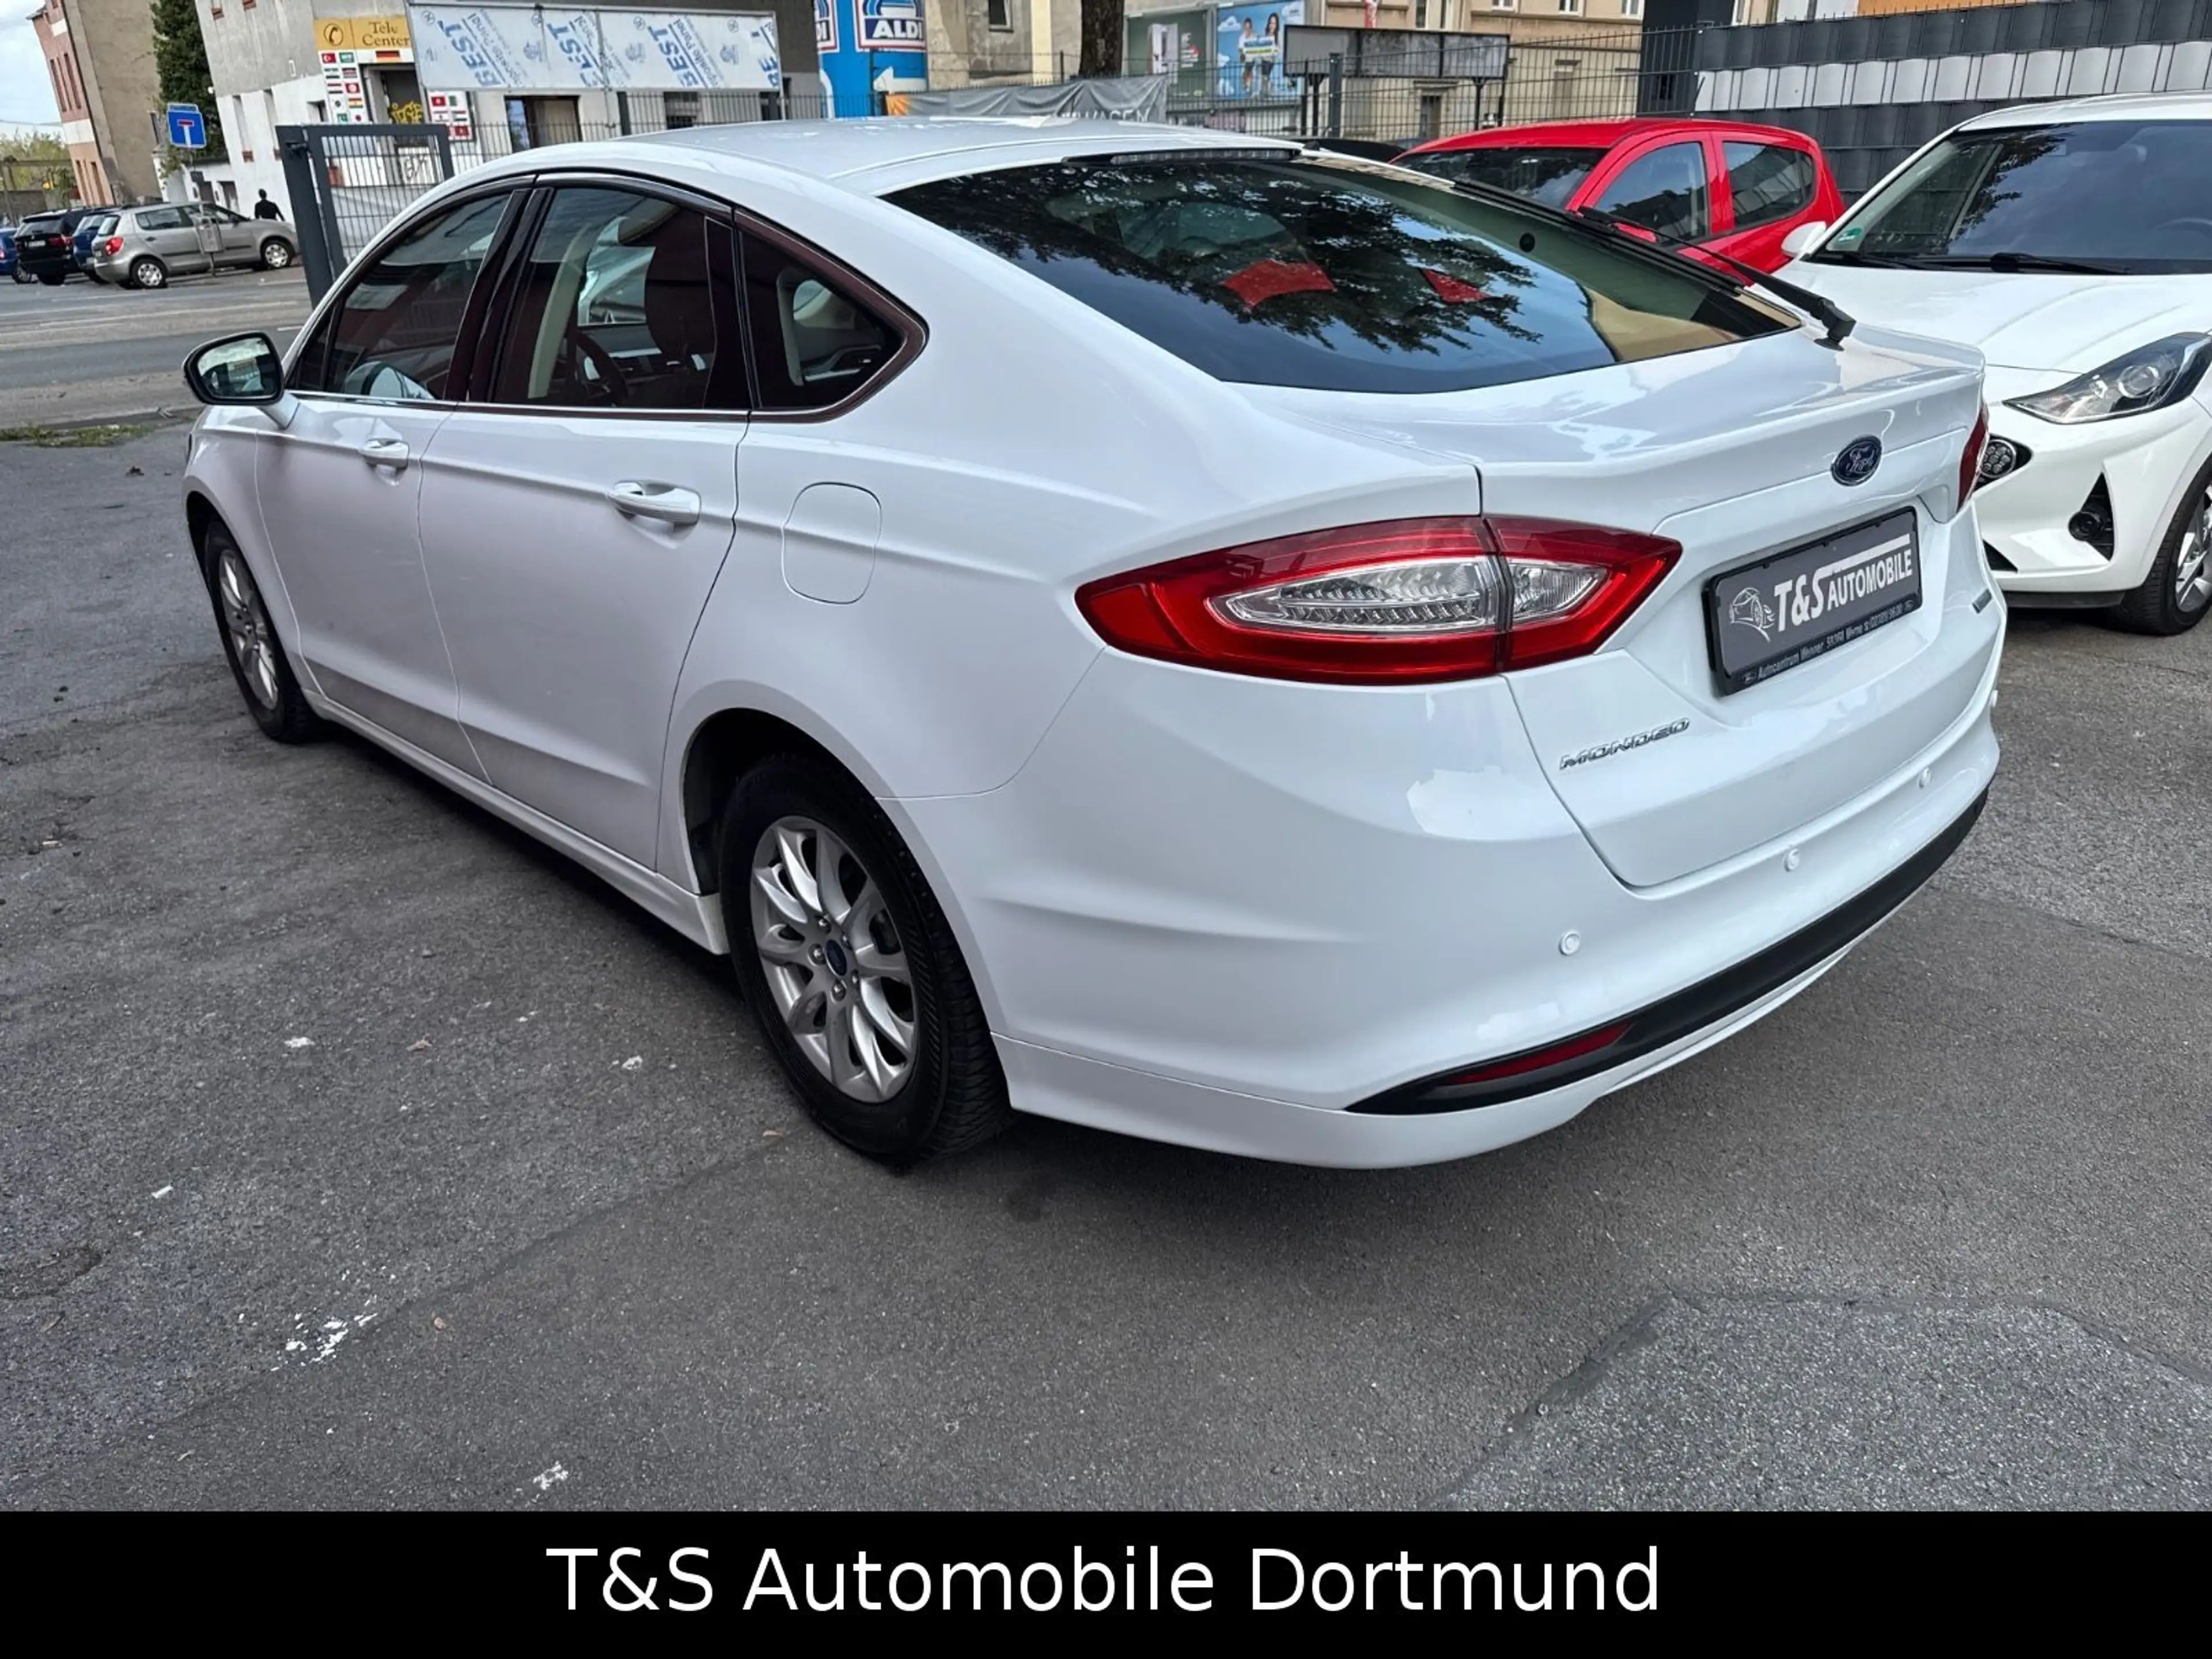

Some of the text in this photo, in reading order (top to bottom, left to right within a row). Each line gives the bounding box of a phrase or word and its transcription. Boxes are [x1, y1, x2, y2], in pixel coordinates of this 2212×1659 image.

[362, 34, 410, 47] Center
[368, 21, 399, 33] Tele
[872, 20, 923, 40] ALDI
[647, 25, 700, 88] BEST
[1774, 567, 1825, 632] T&S
[1827, 548, 1913, 612] AUTOMOBILE
[1559, 717, 1692, 771] MONDEO
